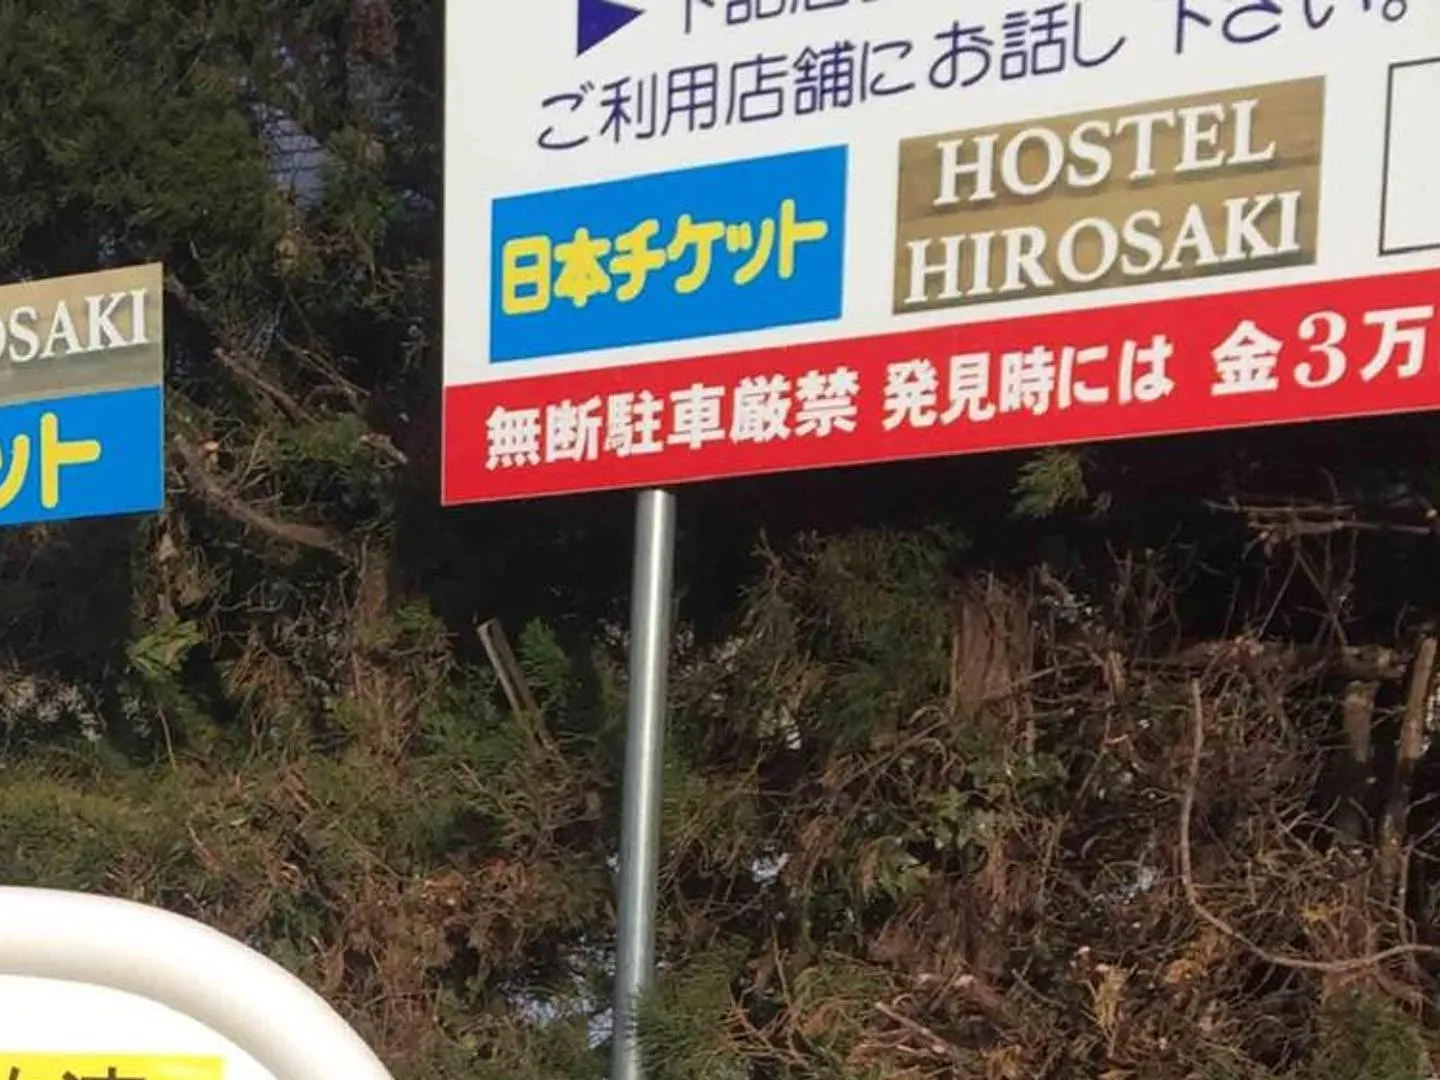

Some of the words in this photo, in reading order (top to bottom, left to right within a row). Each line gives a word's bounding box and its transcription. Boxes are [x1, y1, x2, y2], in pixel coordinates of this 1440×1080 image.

[933, 99, 1277, 206] HOSTEL
[502, 200, 828, 316] 日本チケット
[904, 190, 1301, 303] HIROSAKI
[485, 367, 860, 470] 無断駐車厳禁
[881, 335, 1175, 430] 発見時には
